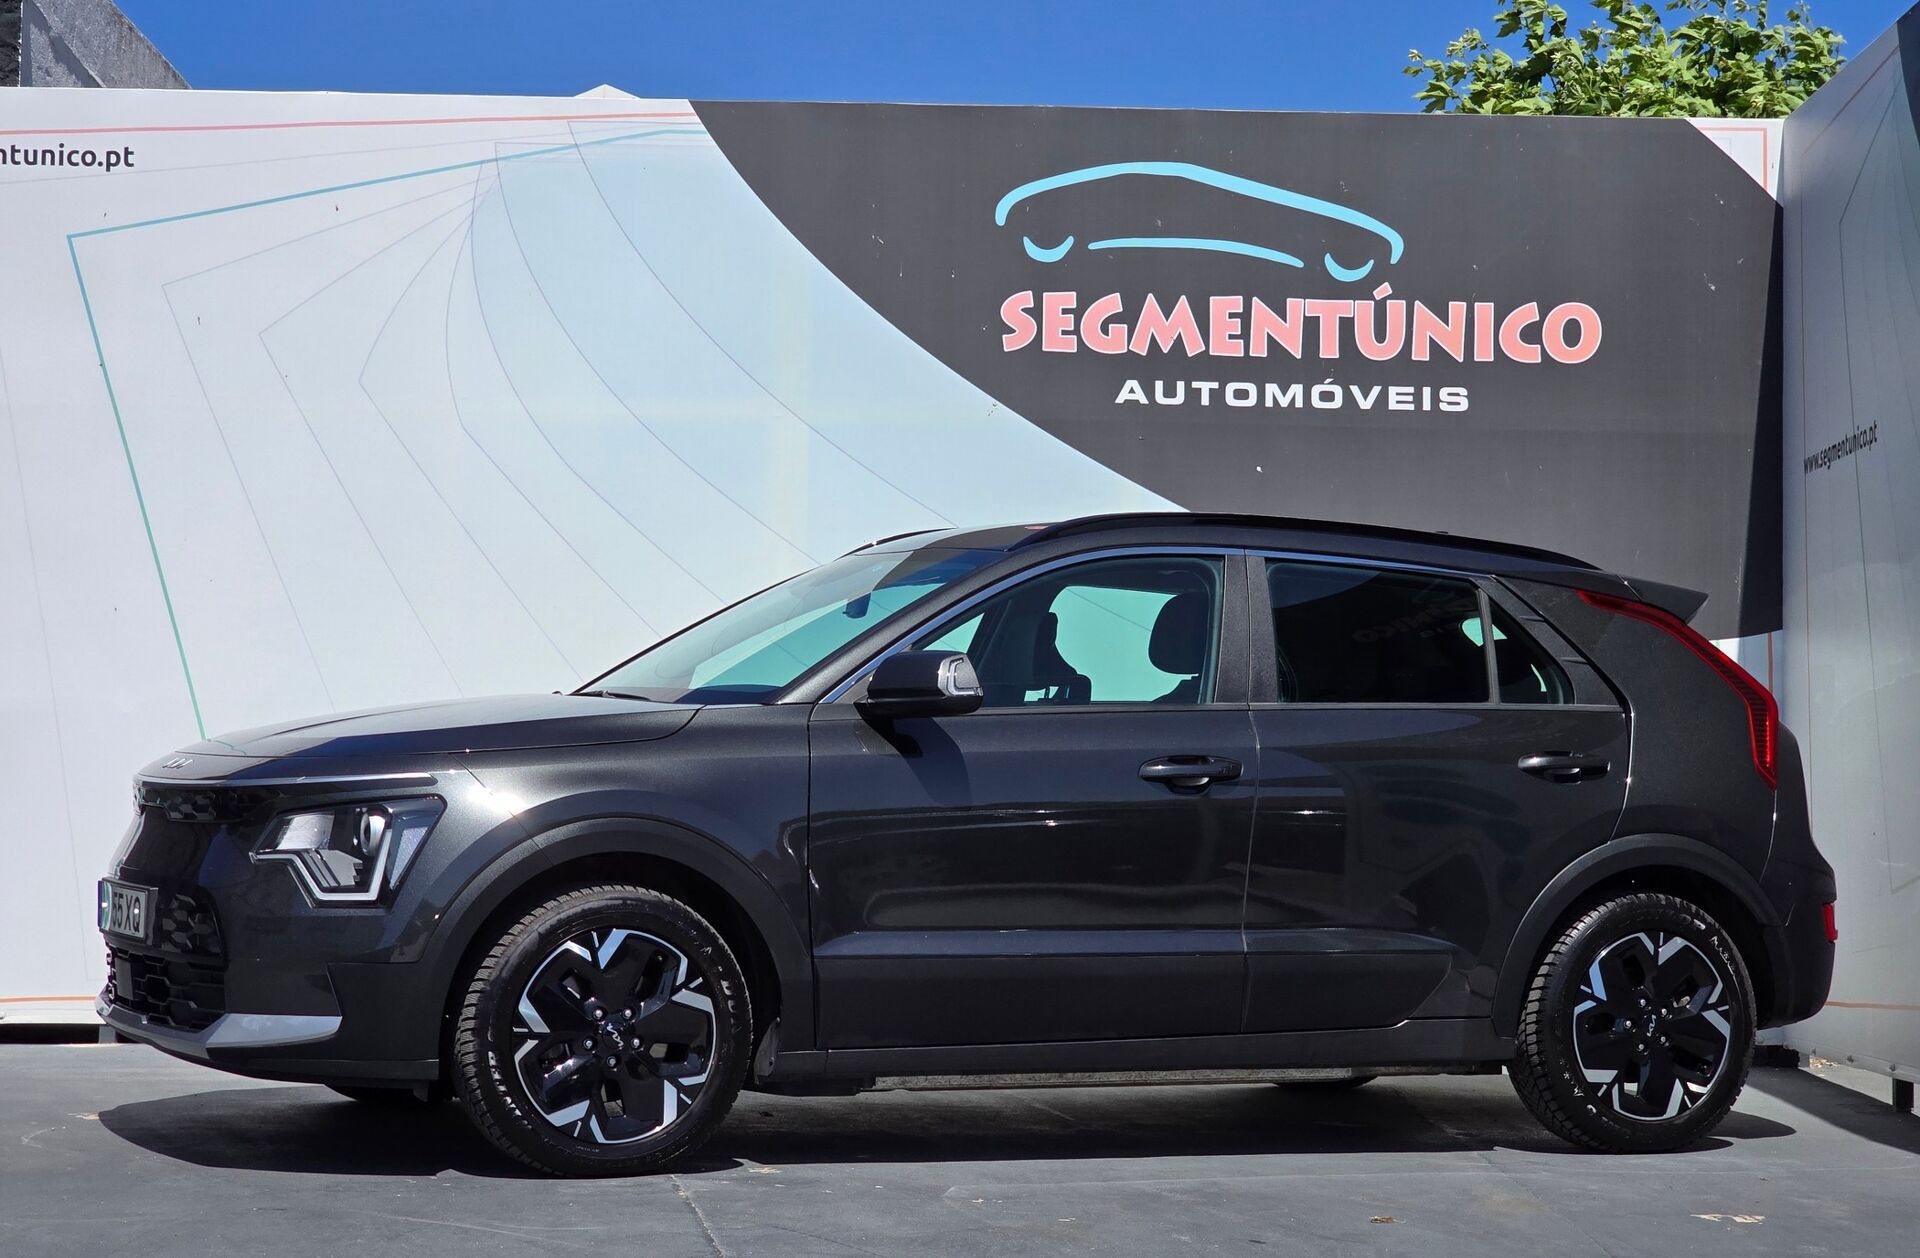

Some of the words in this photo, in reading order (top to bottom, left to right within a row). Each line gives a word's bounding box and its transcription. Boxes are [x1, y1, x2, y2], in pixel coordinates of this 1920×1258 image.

[1000, 282, 1603, 364] SEGMENTÚNICO
[1114, 378, 1470, 413] AUTOMÓVEIS
[1803, 420, 1878, 474] www.segmentunico.pt
